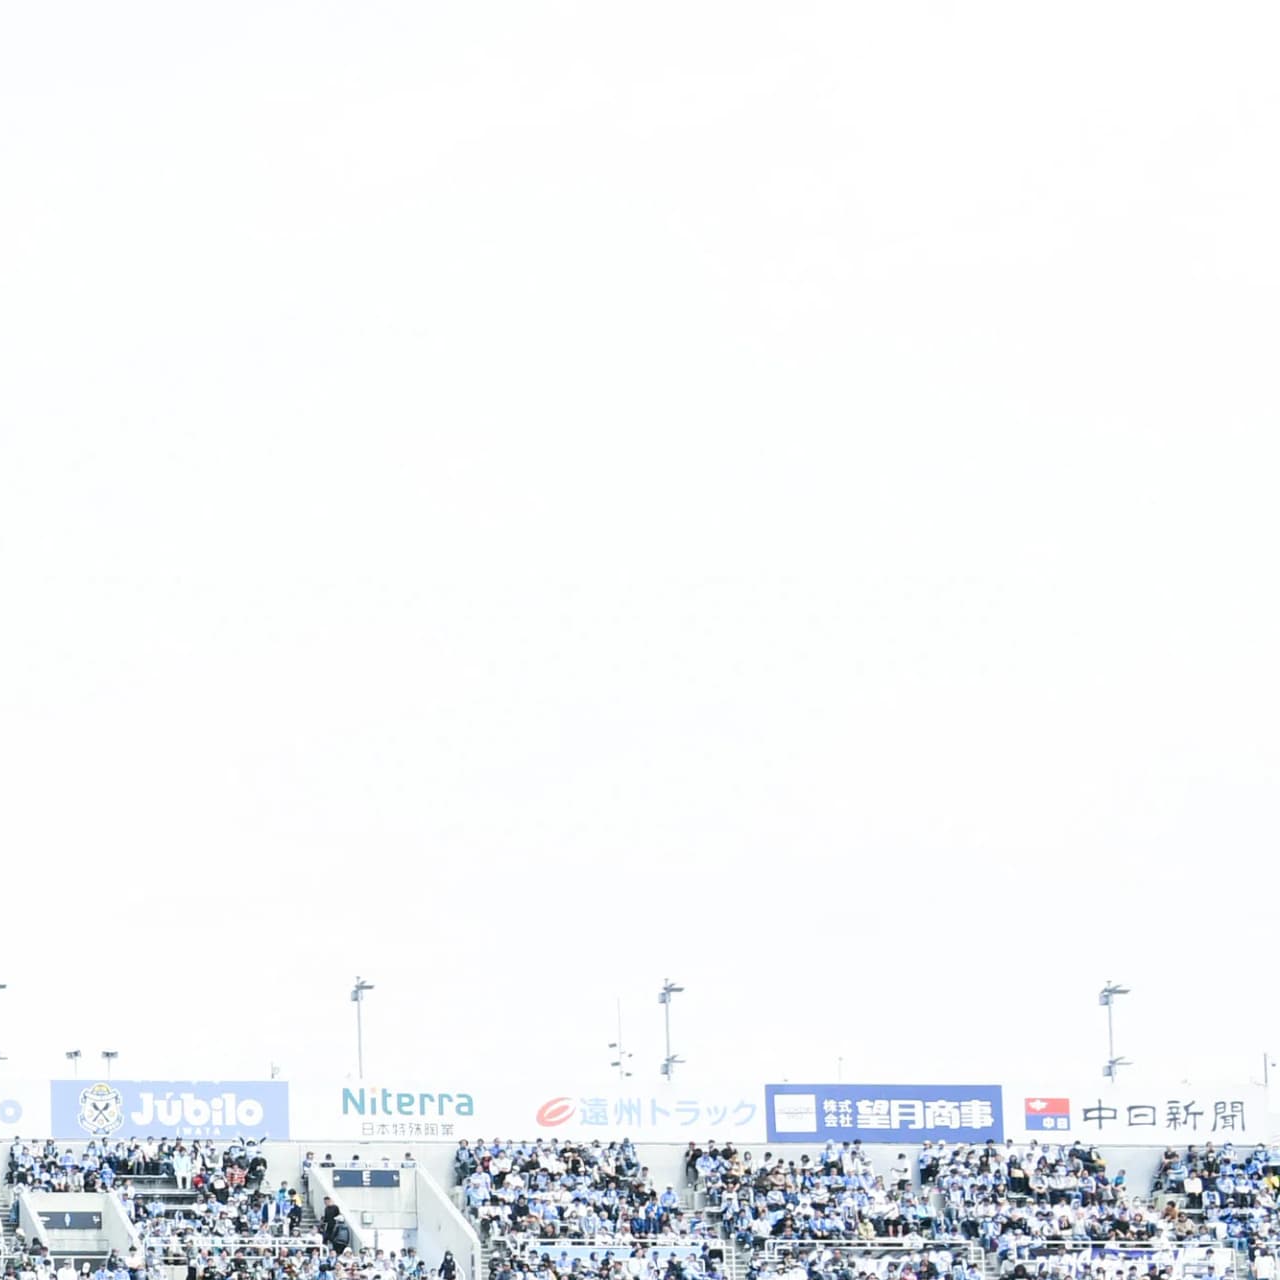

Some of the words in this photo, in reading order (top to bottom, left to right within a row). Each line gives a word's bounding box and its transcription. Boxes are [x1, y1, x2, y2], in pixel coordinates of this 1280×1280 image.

[342, 1087, 474, 1116] Niterra
[580, 1096, 757, 1126] 遠州トラック
[856, 1100, 994, 1129] 望月商事
[1082, 1099, 1245, 1131] 中日新聞
[361, 1122, 455, 1136] 日本特殊陶業
